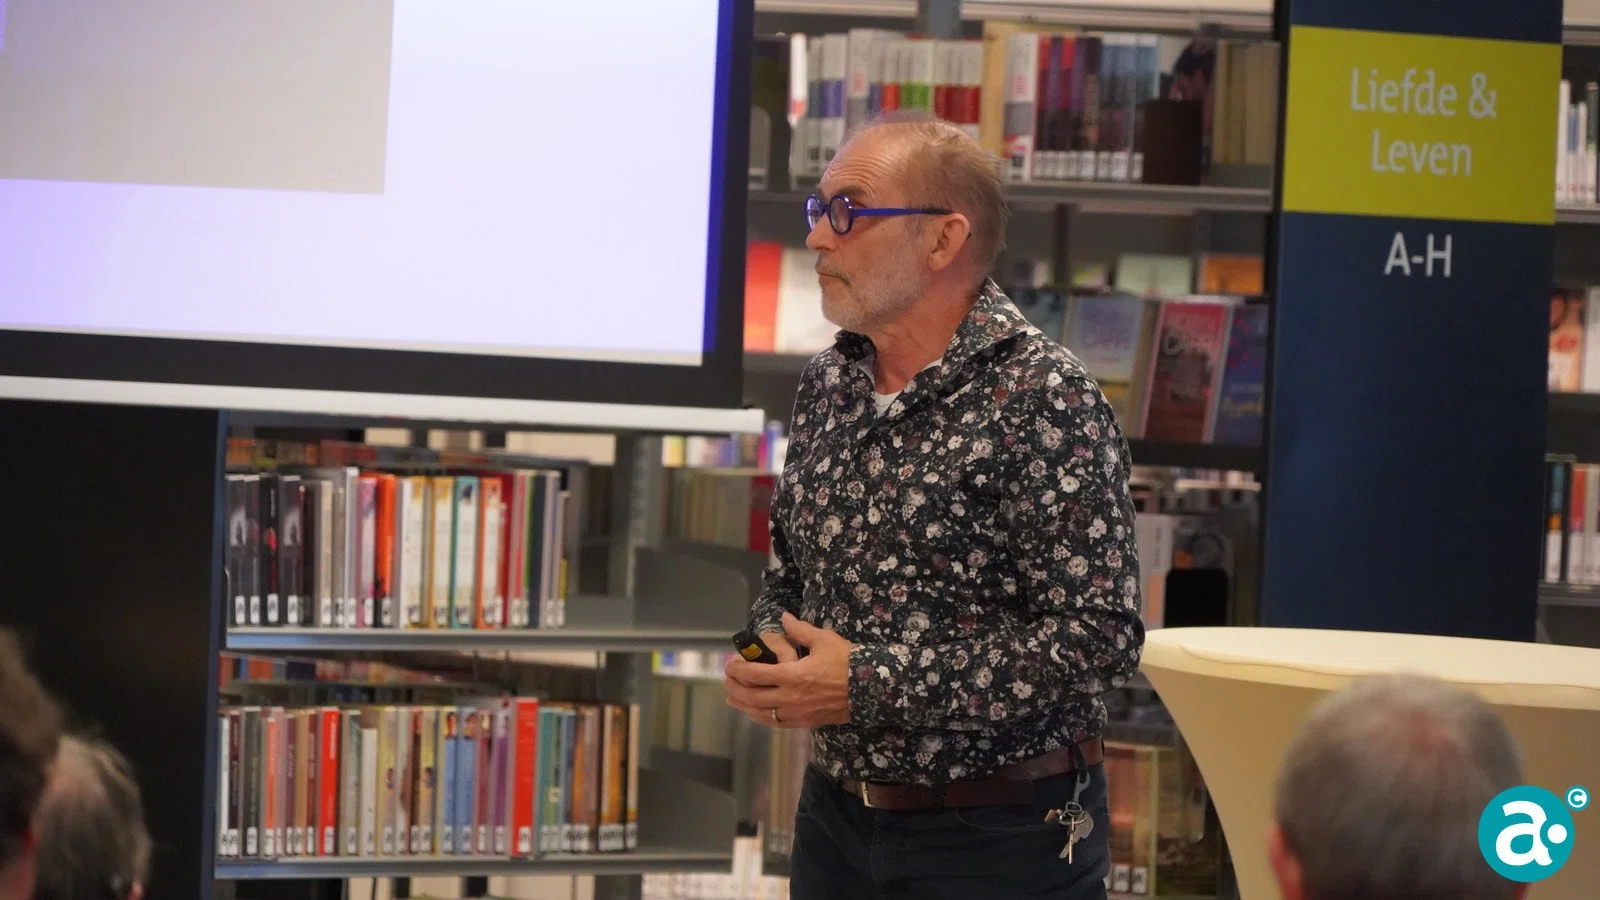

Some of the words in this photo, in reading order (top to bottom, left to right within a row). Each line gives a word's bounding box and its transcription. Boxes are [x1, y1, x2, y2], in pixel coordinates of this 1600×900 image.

[1350, 67, 1458, 117] Liefde
[1468, 72, 1498, 119] &
[1370, 128, 1473, 177] Leven
[1383, 231, 1453, 278] A-H
